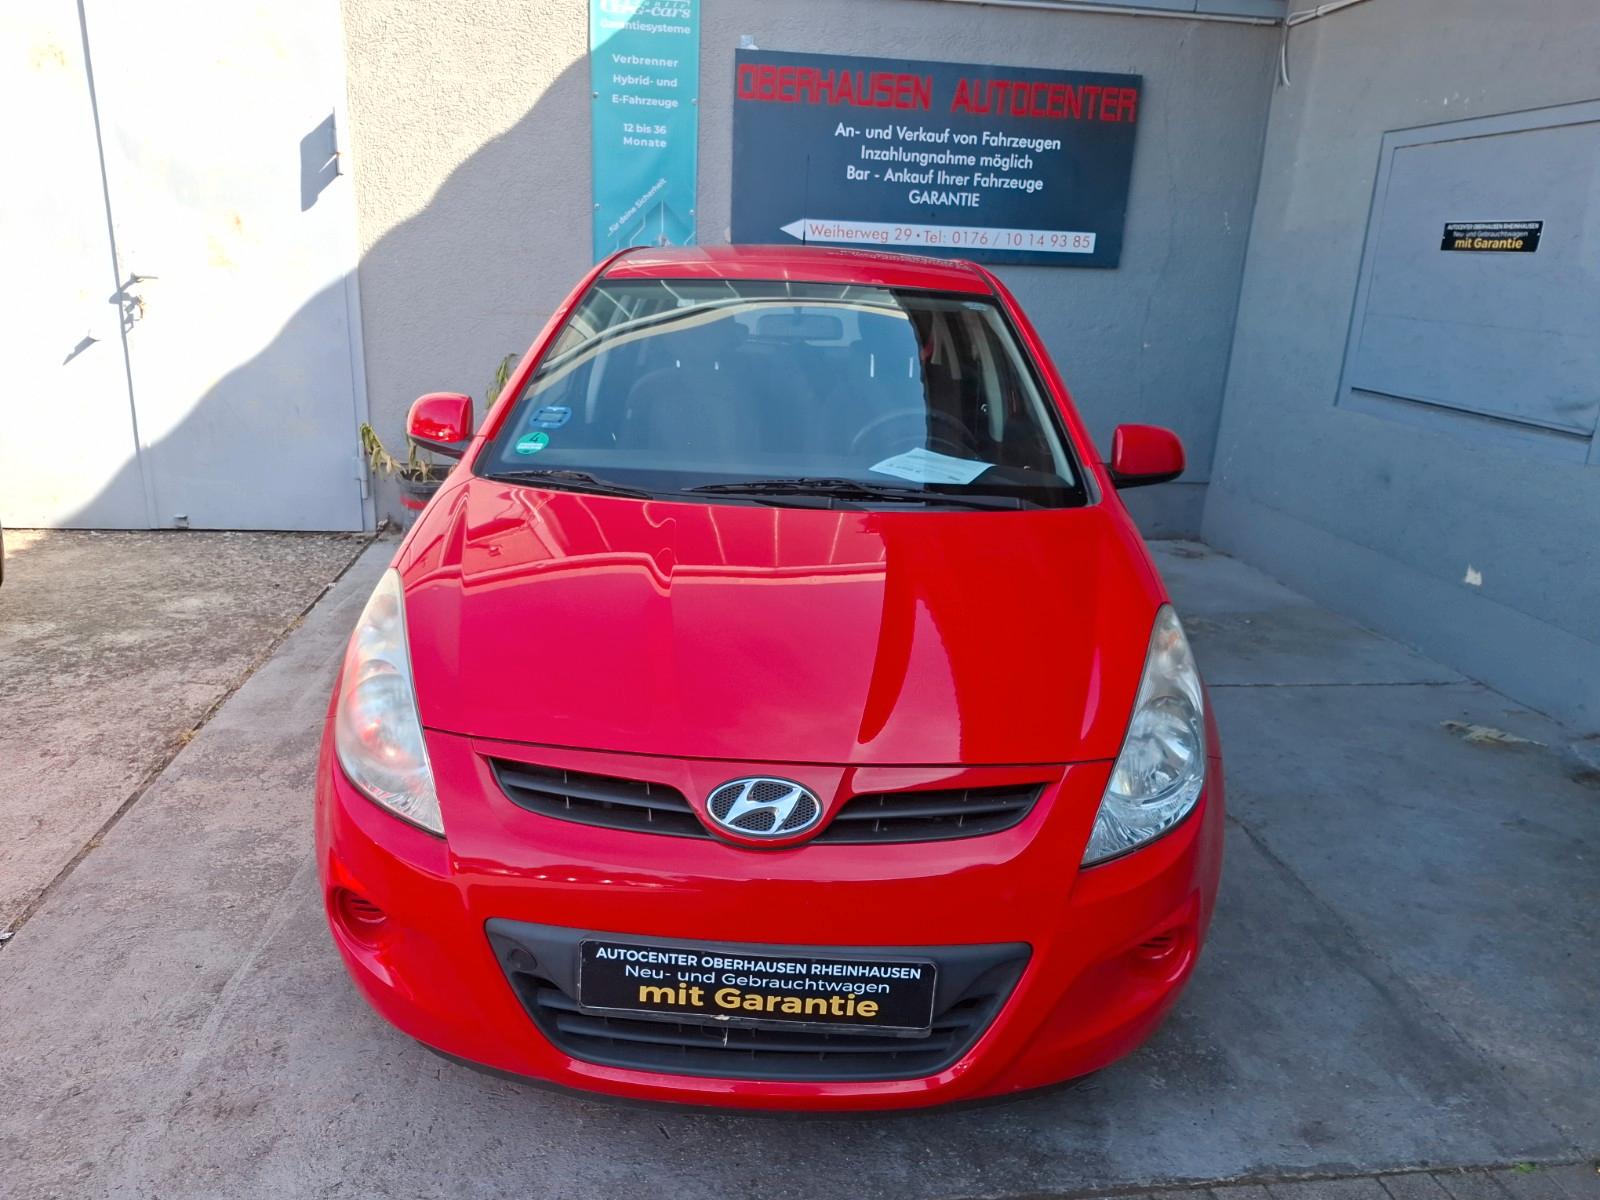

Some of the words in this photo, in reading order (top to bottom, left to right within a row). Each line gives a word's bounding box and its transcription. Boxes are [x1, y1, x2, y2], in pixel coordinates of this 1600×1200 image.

[612, 54, 679, 67] Verbrenner
[613, 74, 654, 86] Hybrid-
[656, 78, 678, 87] und
[612, 94, 679, 109] E-Fahrzeuge
[737, 64, 932, 111] OBERHAUSEN
[951, 77, 1137, 123] AUTOCENTER
[623, 123, 634, 133] 12
[636, 123, 651, 134] bis
[654, 125, 667, 135] 36
[834, 122, 861, 138] An-
[865, 125, 892, 140] und
[896, 126, 950, 144] Verkauf
[953, 133, 977, 145] von
[982, 131, 1061, 152] Fahrzeugen
[623, 137, 667, 148] Monate
[861, 145, 976, 167] Inzahlungnahme
[980, 153, 1033, 171] möglich
[846, 165, 870, 181] Bar
[884, 168, 934, 185] Ankauf
[937, 171, 969, 186] Ihrer
[973, 173, 1043, 193] Fahrzeuge
[908, 190, 980, 207] GARANTIE
[809, 223, 889, 243] Weiherweg
[894, 228, 912, 241] 29
[952, 231, 988, 246] 0176
[1007, 232, 1022, 247] 10
[1029, 233, 1044, 247] 14
[1050, 234, 1067, 248] 93
[1072, 235, 1091, 249] 85
[1455, 237, 1472, 248] mit
[1473, 237, 1524, 249] Garantie
[529, 432, 540, 443] 4
[596, 947, 697, 967] AUTOCENTER
[701, 957, 807, 975] OBERHAUSEN
[811, 964, 921, 980] RHEINHAUSEN
[625, 964, 671, 980] Neu-
[677, 971, 715, 984] und
[722, 973, 890, 995] Gebrauchtwagen
[639, 983, 704, 1006] mit
[714, 987, 879, 1018] Garantie
